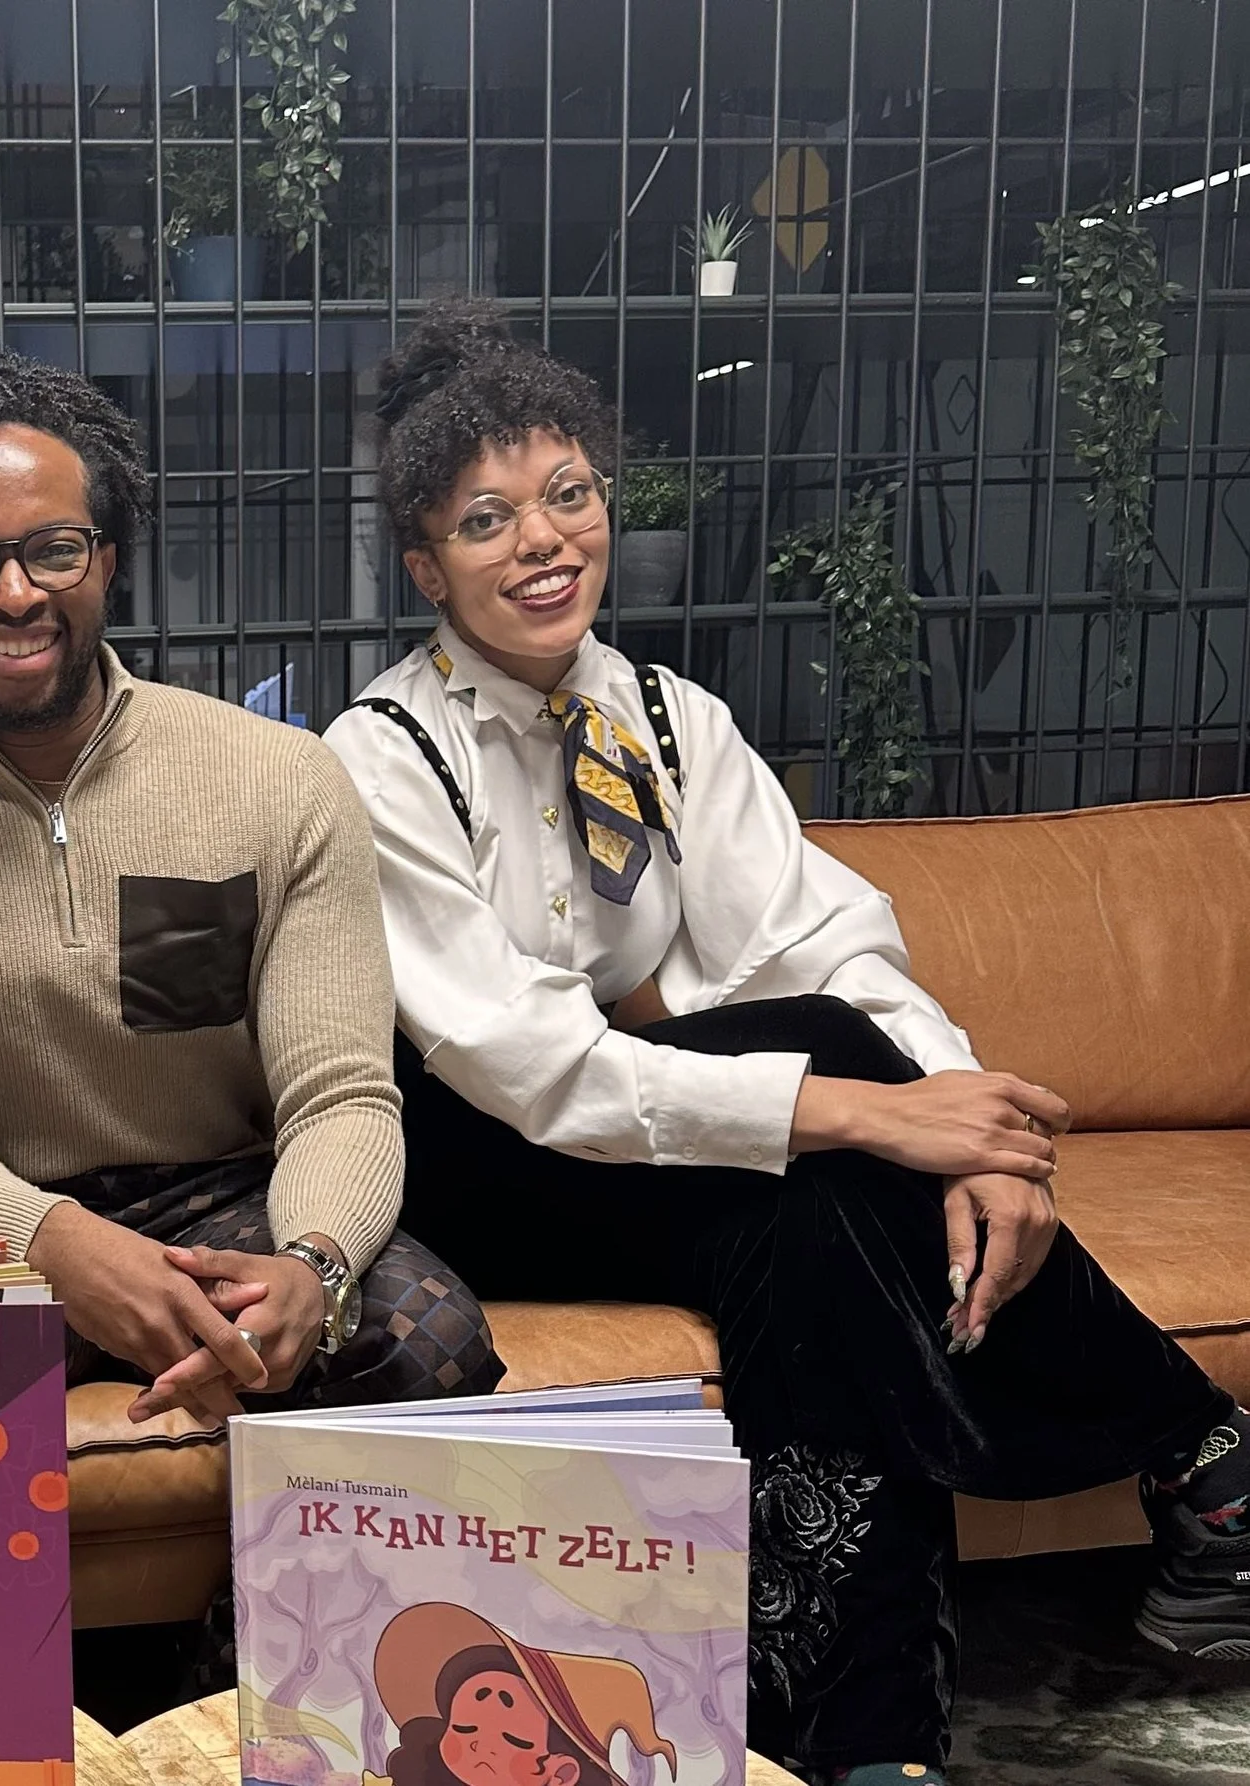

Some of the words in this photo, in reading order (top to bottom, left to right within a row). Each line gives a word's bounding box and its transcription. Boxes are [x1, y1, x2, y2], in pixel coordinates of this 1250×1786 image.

[342, 1480, 409, 1498] Tusmain
[299, 1501, 343, 1537] IK
[354, 1505, 445, 1550] KAN
[457, 1514, 546, 1563] HET
